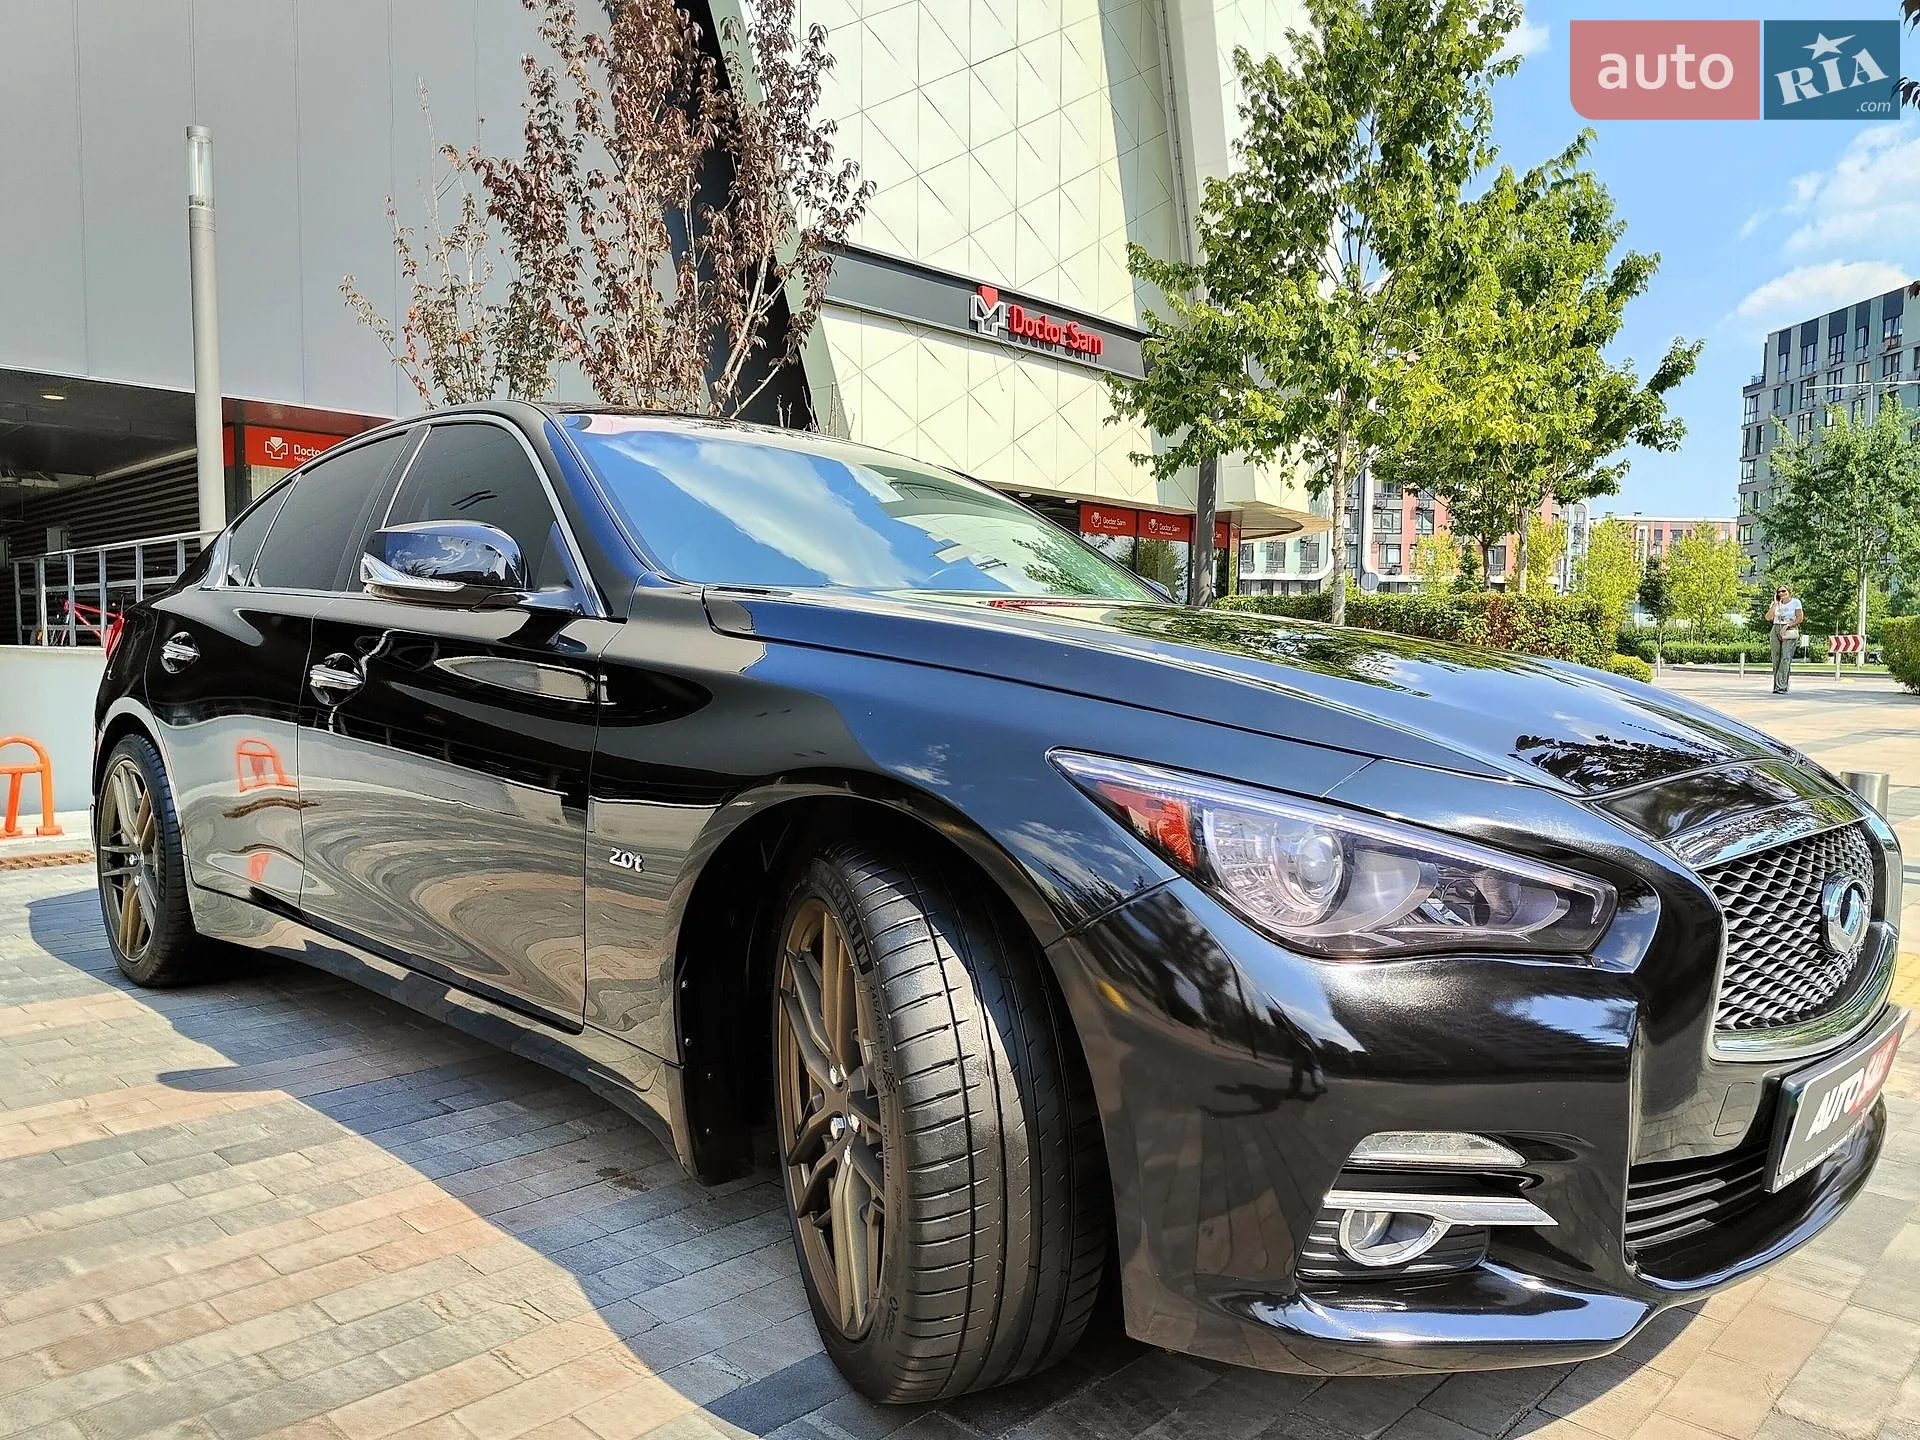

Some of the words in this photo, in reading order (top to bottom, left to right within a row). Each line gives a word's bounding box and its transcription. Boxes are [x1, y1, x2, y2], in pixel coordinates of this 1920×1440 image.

[1008, 304, 1067, 345] Doctor
[1067, 321, 1104, 356] Sam
[293, 444, 321, 457] Docto
[1805, 1067, 1865, 1142] AUTO
